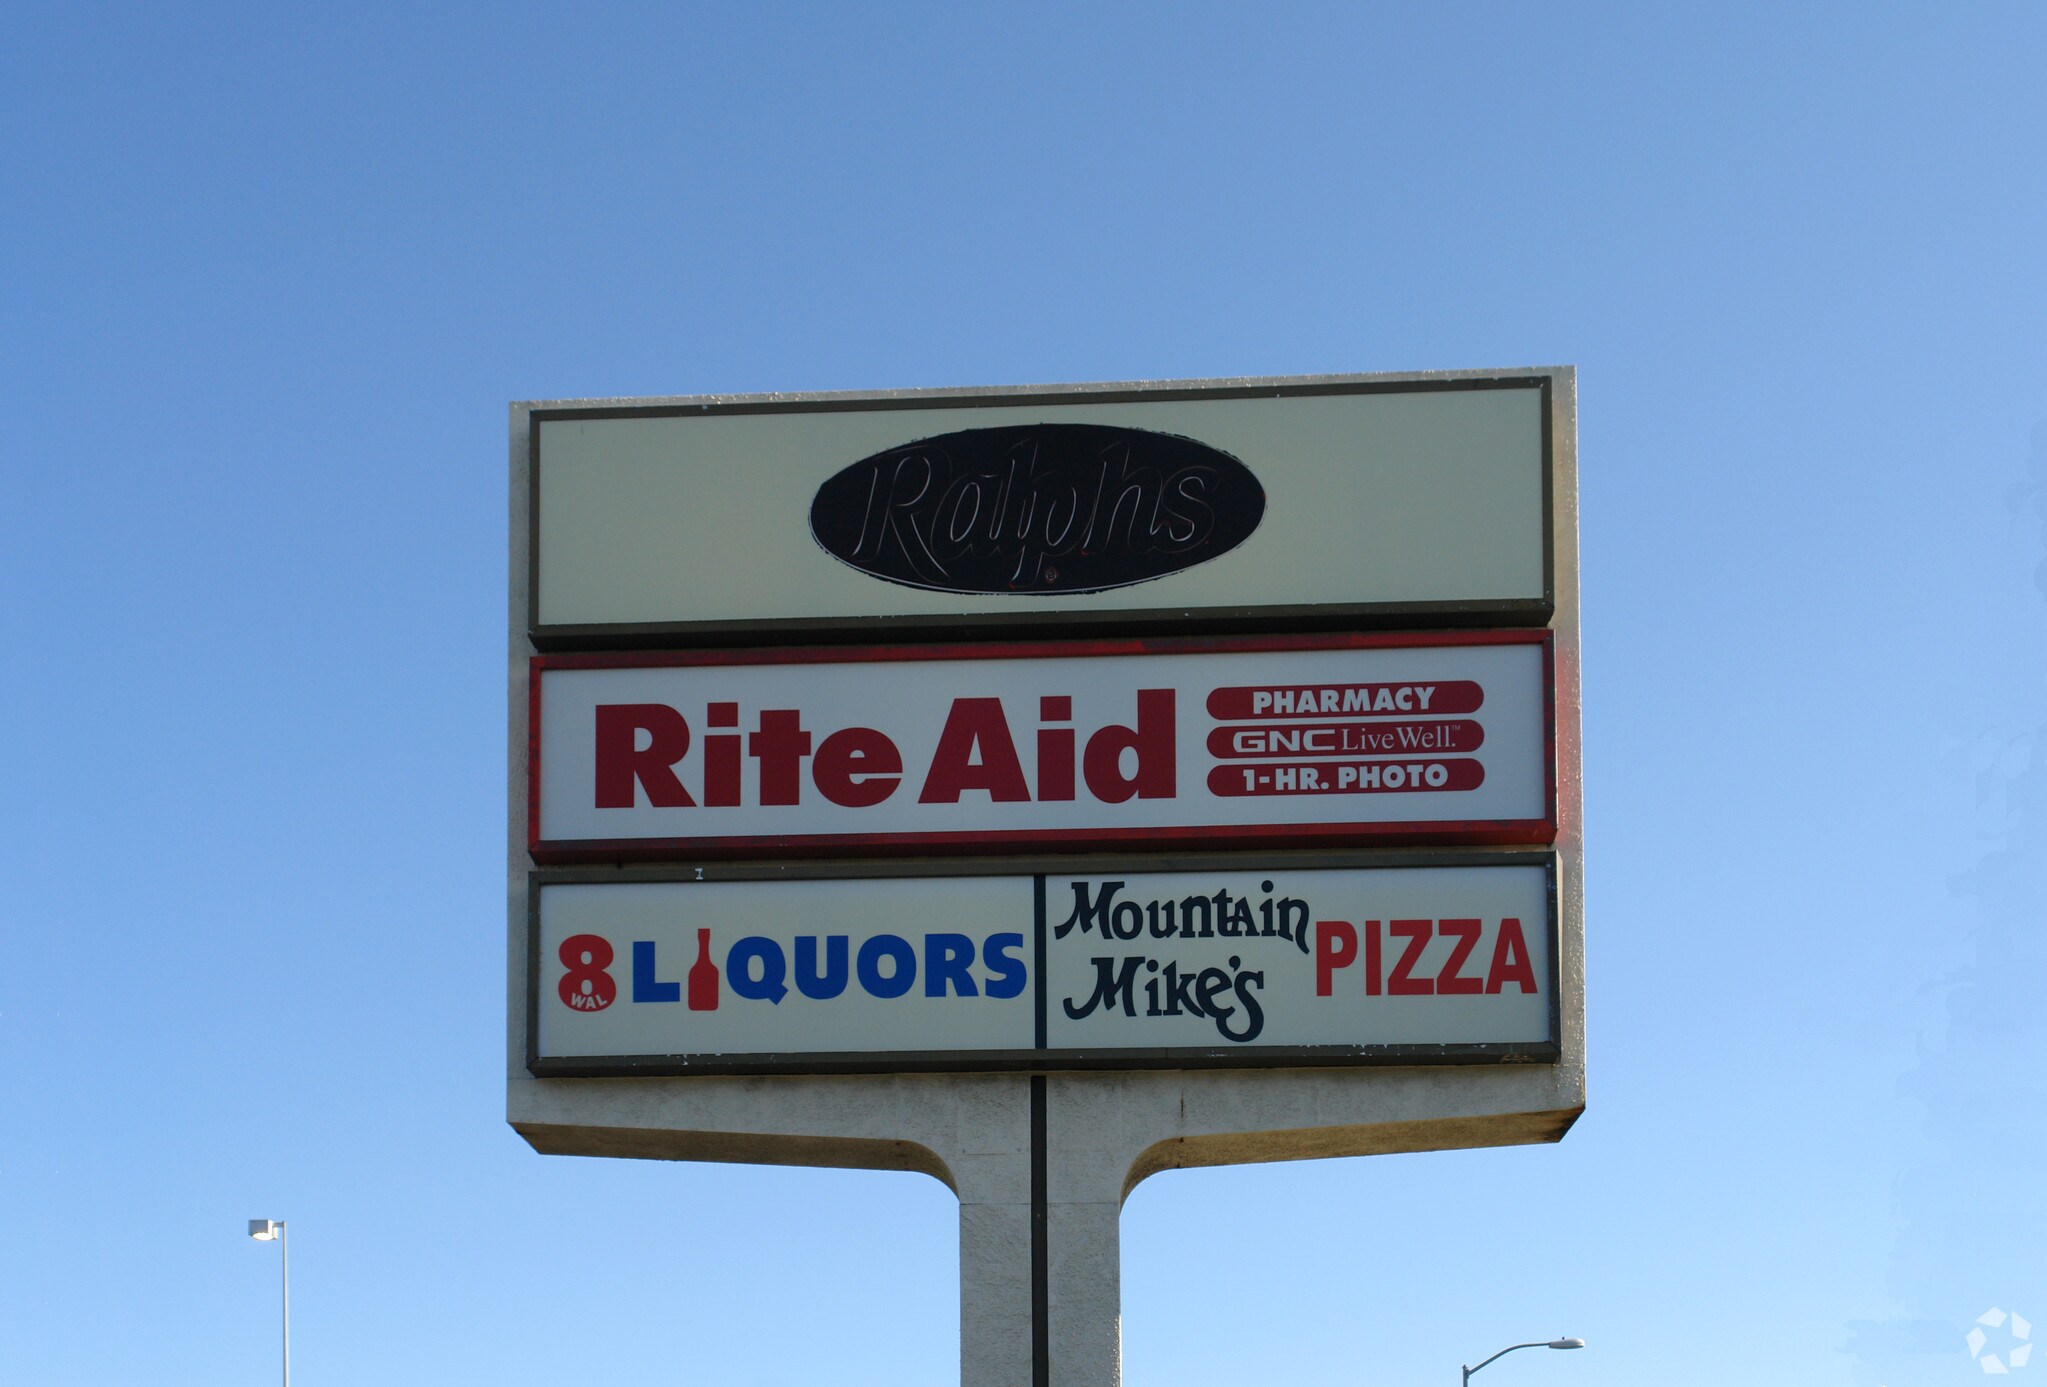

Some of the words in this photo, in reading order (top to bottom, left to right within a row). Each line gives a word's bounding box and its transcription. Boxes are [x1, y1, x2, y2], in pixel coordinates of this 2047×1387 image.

[850, 438, 1220, 588] Ralphs
[1253, 686, 1436, 715] PHARMACY
[595, 702, 903, 808] Rite
[917, 687, 1176, 804] Aid
[1232, 729, 1336, 753] GNC
[1243, 768, 1330, 791] 1-HR.
[1338, 763, 1449, 790] PHOTO
[557, 933, 617, 1012] 8
[1315, 917, 1538, 998] PIZZA
[570, 992, 608, 1009] WAL
[1062, 955, 1265, 1043] Mike's
